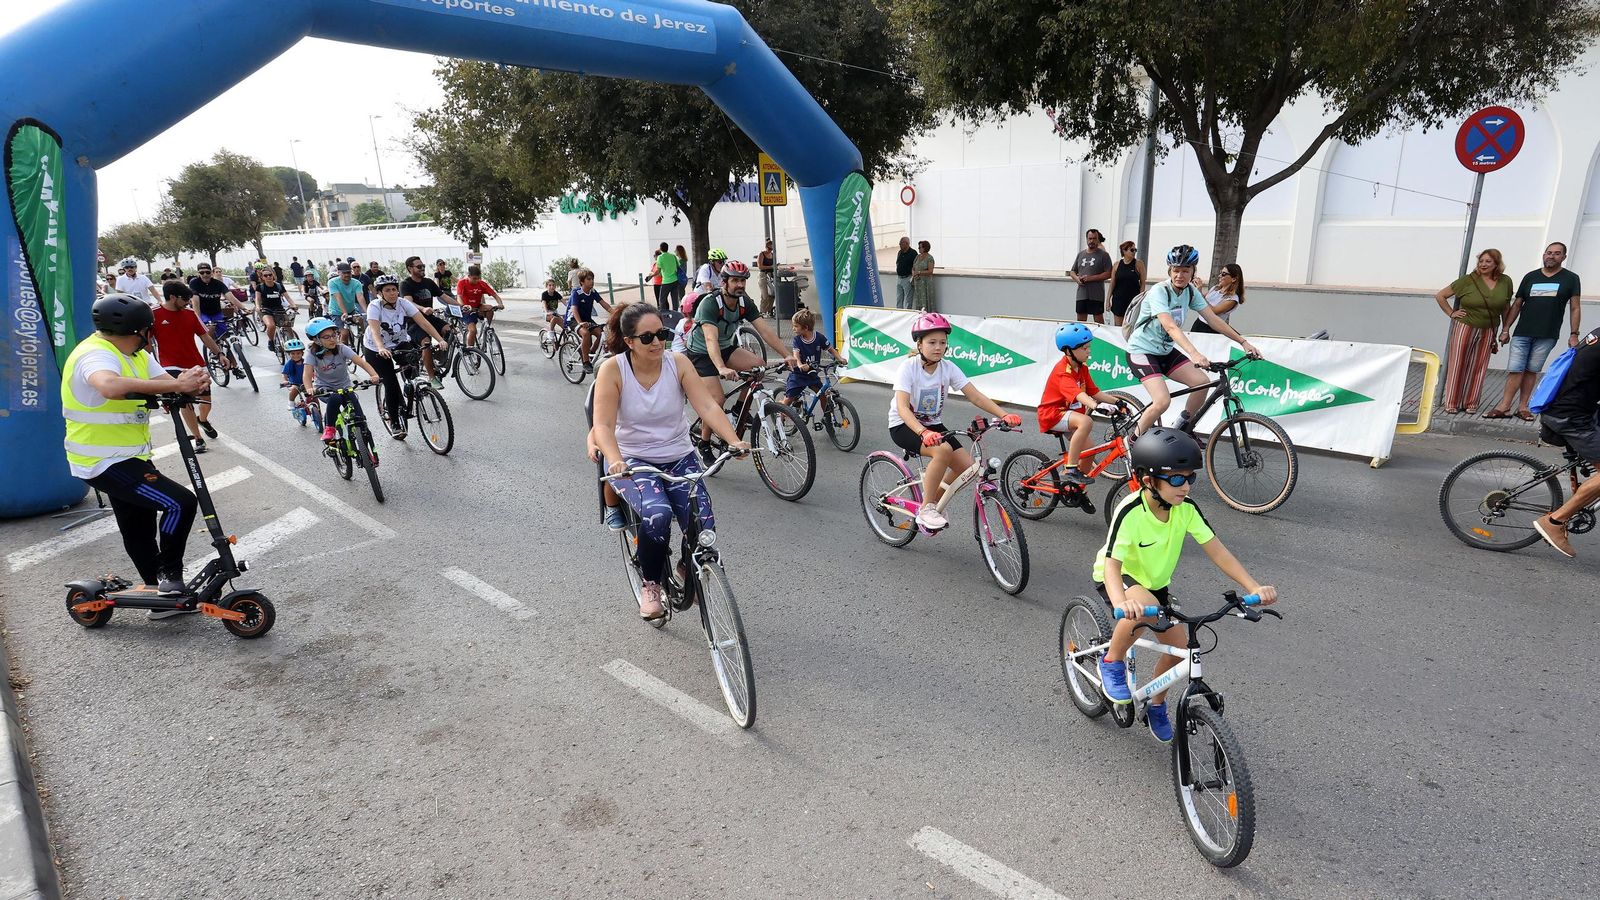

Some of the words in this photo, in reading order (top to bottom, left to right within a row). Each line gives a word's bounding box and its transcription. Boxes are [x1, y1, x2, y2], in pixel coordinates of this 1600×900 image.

[620, 9, 648, 24] de
[653, 13, 708, 34] Jerez
[850, 336, 858, 348] El
[857, 337, 875, 351] Corte
[874, 336, 900, 356] Inglés
[953, 346, 977, 362] Corte
[977, 345, 1014, 367] Inglés
[1229, 376, 1245, 394] El
[1245, 379, 1281, 398] Corte
[1280, 379, 1336, 406] Inglés
